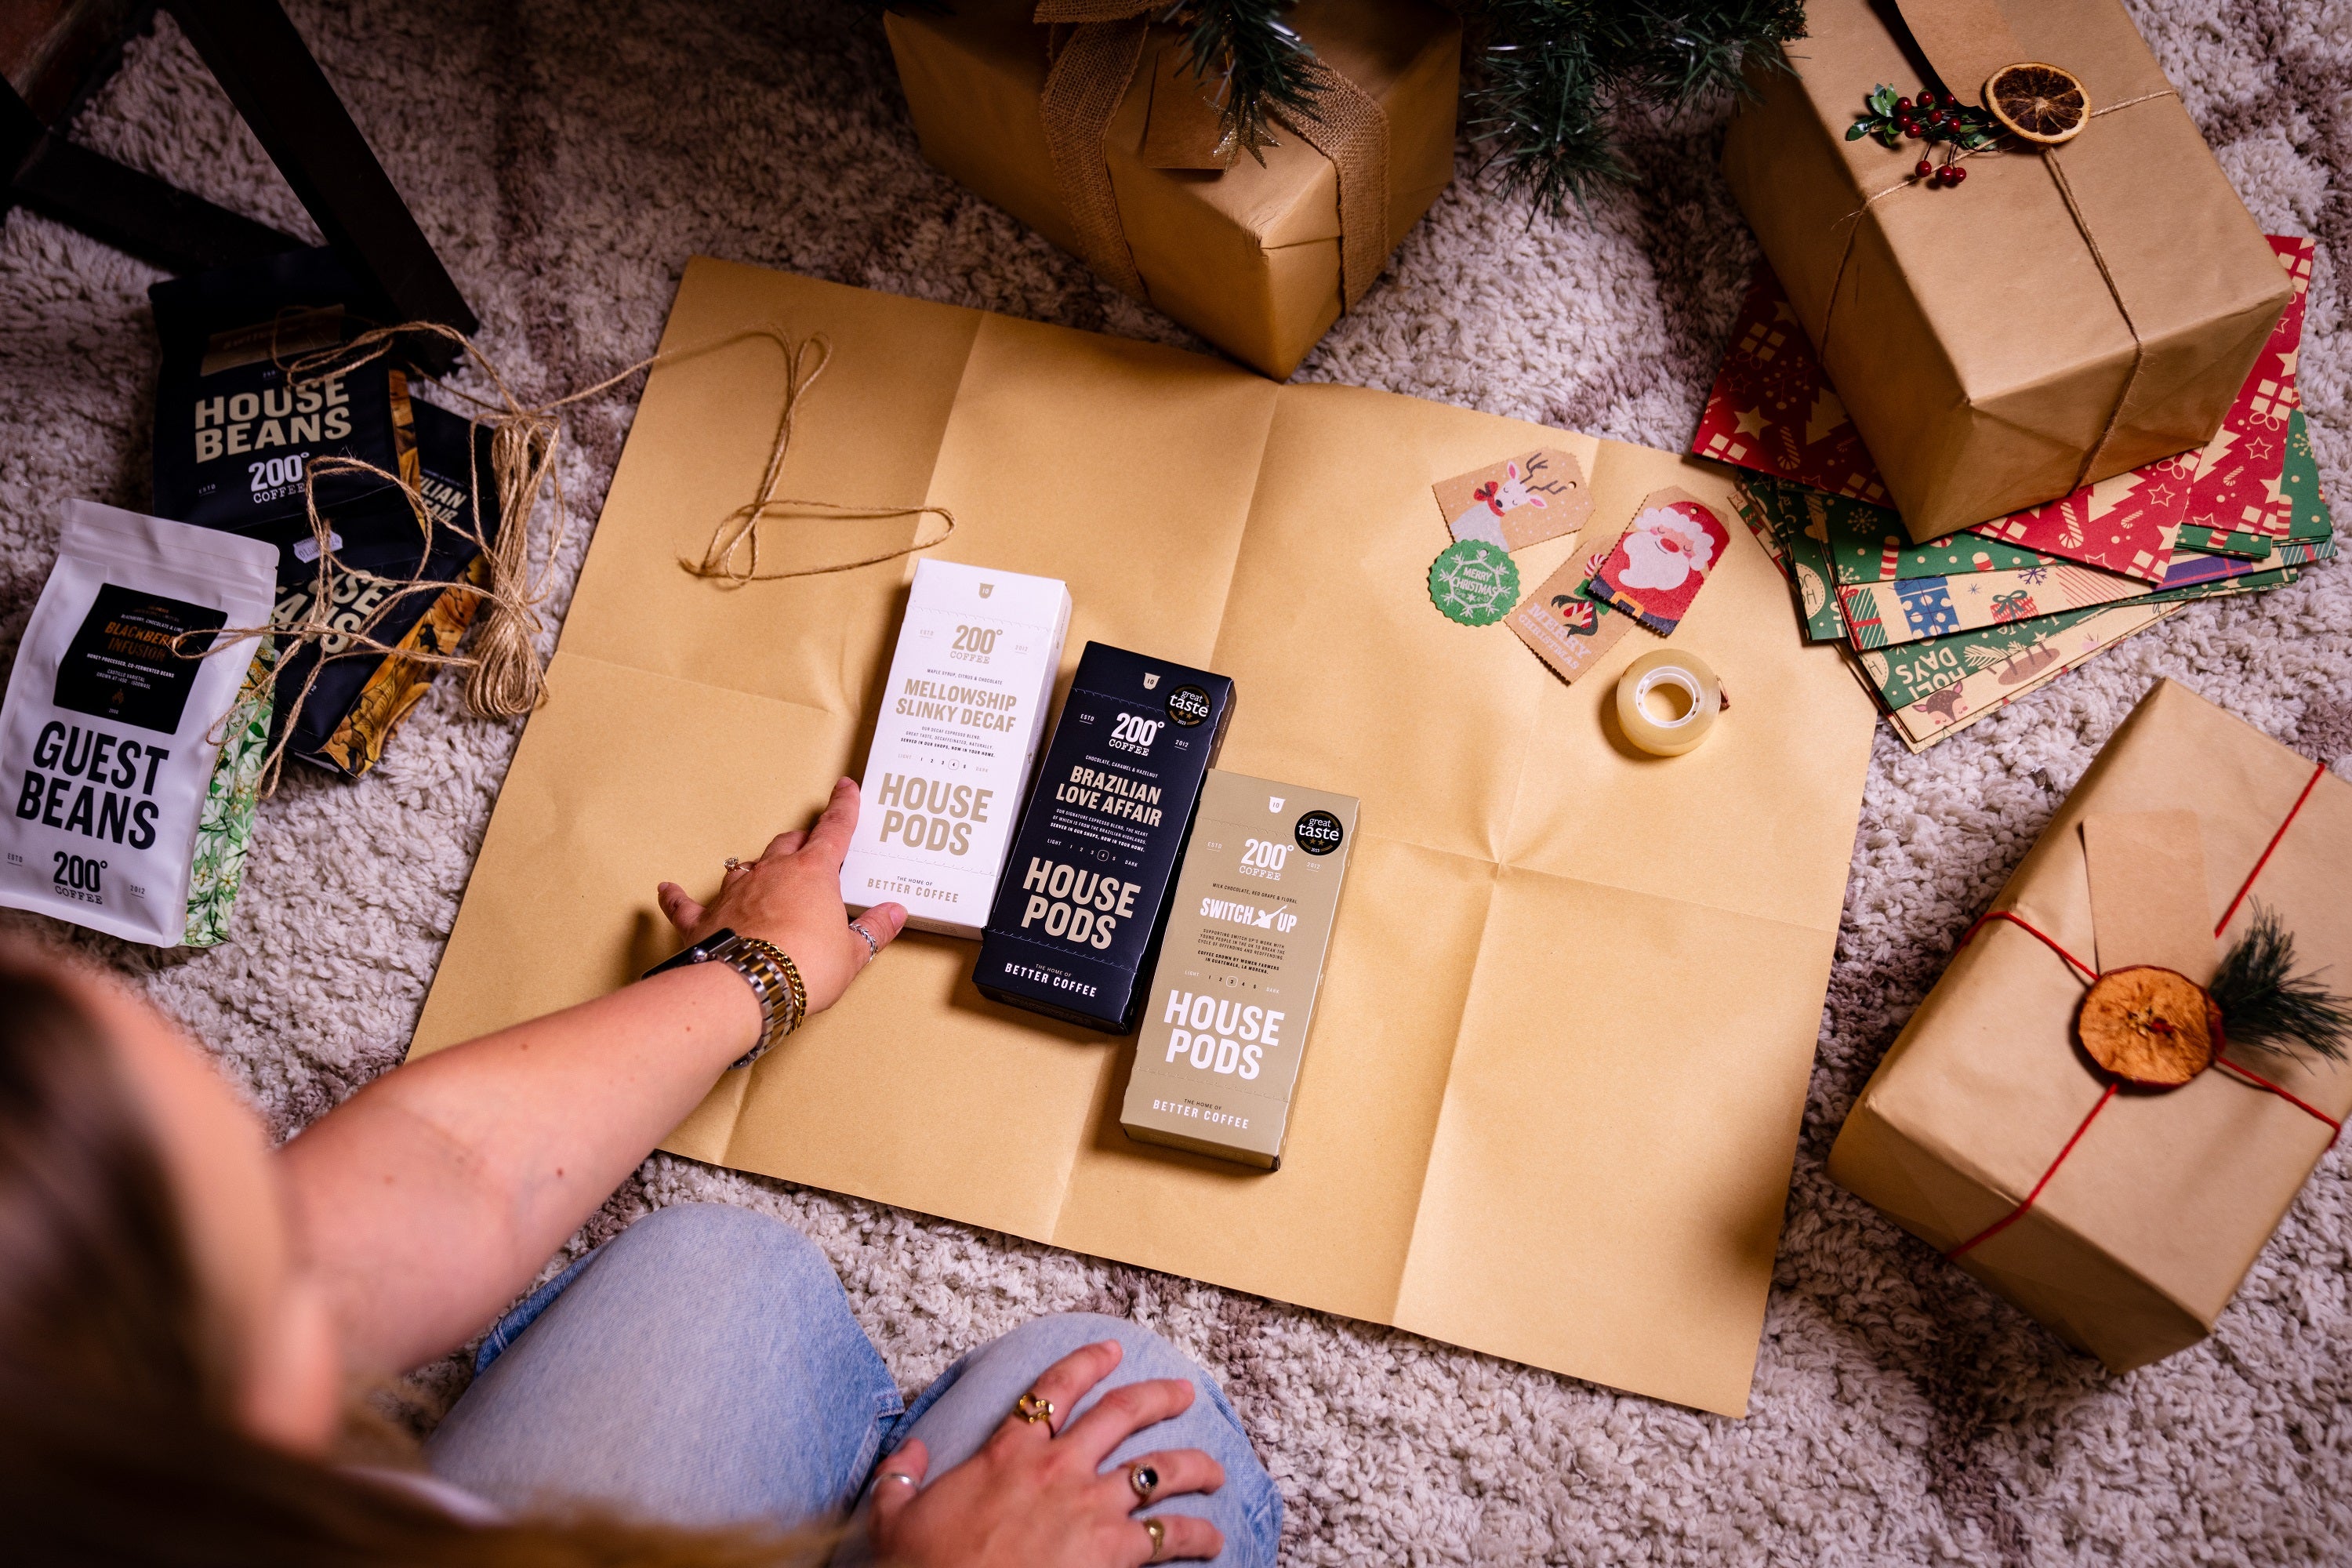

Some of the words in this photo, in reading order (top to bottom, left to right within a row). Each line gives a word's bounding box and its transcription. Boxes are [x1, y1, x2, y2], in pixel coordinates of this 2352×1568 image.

[195, 372, 350, 430] HOUSE
[195, 407, 352, 464] BEANS
[252, 482, 305, 504] COFFEE
[1452, 576, 1498, 595] CHRISTMAS
[1463, 567, 1493, 583] MERRY
[951, 622, 1004, 655] 200°
[1518, 615, 1580, 670] CHRISTMAS
[1529, 603, 1594, 659] MERRY
[86, 652, 101, 661] HONEY
[107, 637, 166, 662] INFUSION
[949, 651, 990, 664] COFFEE
[1895, 647, 1958, 684] DAYS
[903, 678, 1017, 712] MELLOWSHIP
[1170, 695, 1208, 717] taste
[1181, 691, 1203, 702] great
[895, 697, 958, 723] SLINKY
[960, 708, 1016, 733] DECAF
[1110, 711, 1165, 749] 200°
[33, 720, 169, 796] GUEST
[1107, 738, 1149, 756] COFFEE
[1085, 755, 1111, 765] CHOCOLATE,
[1111, 761, 1131, 771] CARAMEL
[1135, 768, 1158, 779] HAZELNUT
[877, 771, 993, 822] HOUSE
[1069, 764, 1162, 804] BRAZILIAN
[16, 770, 158, 849] BEANS
[1055, 782, 1101, 809] LOVE
[1099, 795, 1163, 827] AFFAIR
[1065, 811, 1088, 820] SIGNATURE
[1088, 817, 1109, 826] ESPRESSO
[1308, 818, 1331, 827] great
[879, 809, 974, 857] PODS
[1083, 831, 1100, 840] SHOPS,
[1098, 828, 1121, 837] BRAZILIAN
[1121, 834, 1147, 844] HIGHLANDS.
[1298, 824, 1339, 840] taste
[7, 853, 23, 862] ESTD
[1240, 836, 1294, 873] 200°
[1238, 865, 1281, 880] COFFEE
[55, 886, 103, 905] COFFEE
[130, 885, 145, 895] 2012
[867, 877, 911, 894] BETTER
[915, 886, 959, 902] COFFEE
[1022, 855, 1142, 919] HOUSE
[1224, 885, 1250, 895] CHOCOLATE,
[1020, 894, 1119, 951] PODS
[1199, 896, 1254, 925] SWITCH
[1276, 913, 1298, 934] UP
[1203, 928, 1229, 937] SUPPORTING
[1218, 943, 1243, 952] OFFENDING
[1211, 958, 1240, 968] GUATEMALA,
[1004, 963, 1049, 983] BETTER
[1052, 976, 1097, 997] COFFEE
[1163, 989, 1285, 1046] HOUSE
[1165, 1027, 1265, 1081] PODS
[1152, 1099, 1199, 1118] BETTER
[1203, 1110, 1249, 1129] COFFEE
